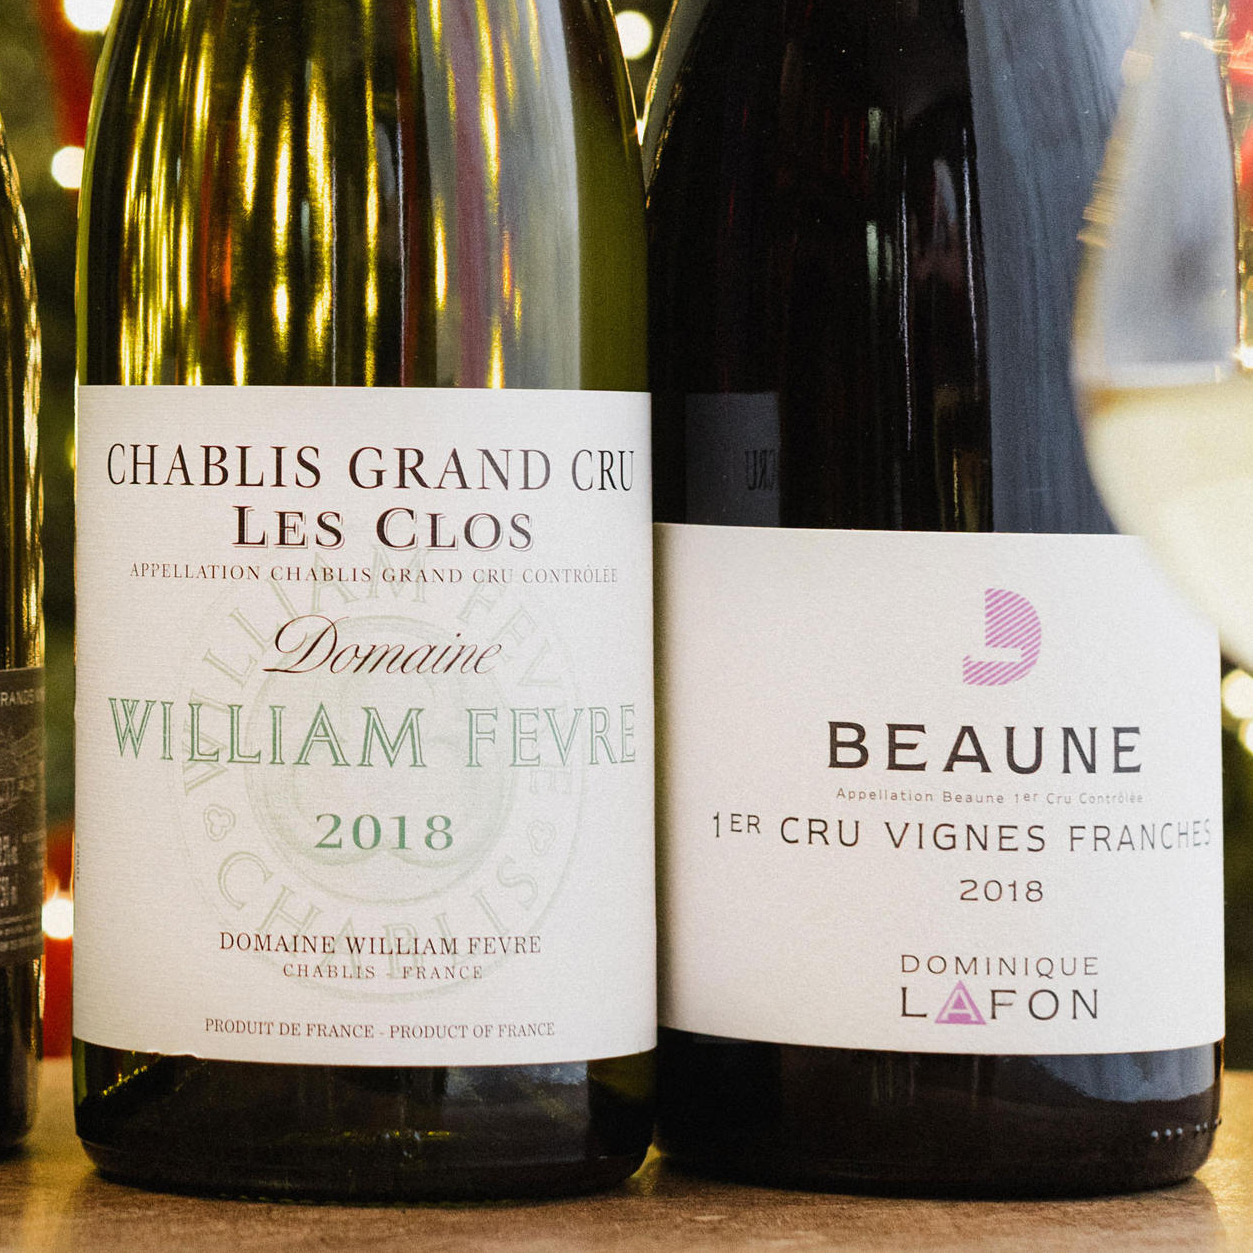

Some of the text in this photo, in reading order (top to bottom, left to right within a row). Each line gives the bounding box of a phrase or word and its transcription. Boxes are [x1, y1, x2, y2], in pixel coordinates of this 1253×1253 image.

[107, 442, 636, 492] CHABLIS GRAND CRU
[232, 504, 533, 550] LES CLOS
[130, 562, 260, 581] APPELLATION
[270, 566, 372, 584] CHABLIS
[381, 568, 464, 584] GRAND
[472, 568, 510, 584] CRU
[262, 616, 502, 674] Domaine
[107, 696, 636, 769] WILLIAM FEVRE
[827, 720, 1143, 776] BEAUNE
[835, 786, 934, 803] Appellation
[942, 790, 1006, 805] Beaune
[1045, 792, 1072, 806] Cru
[313, 812, 455, 852] 2018
[712, 811, 1211, 854] 1ER CRU VIGNES FRANCHES
[959, 878, 1044, 903] 2018
[220, 931, 542, 956] DOMAINE WILLIAM FEVRE
[282, 962, 376, 980] CHABLIS
[401, 964, 484, 980] FRANCE
[900, 952, 1099, 980] DOMINIQUE
[900, 980, 1099, 1026] LAFON
[204, 1016, 274, 1036] PRODUIT
[278, 1021, 302, 1037] DE
[306, 1022, 375, 1039] FRANCE
[388, 1024, 468, 1040] PRODUCT
[472, 1024, 496, 1039] OF
[499, 1021, 556, 1039] FRANCE
